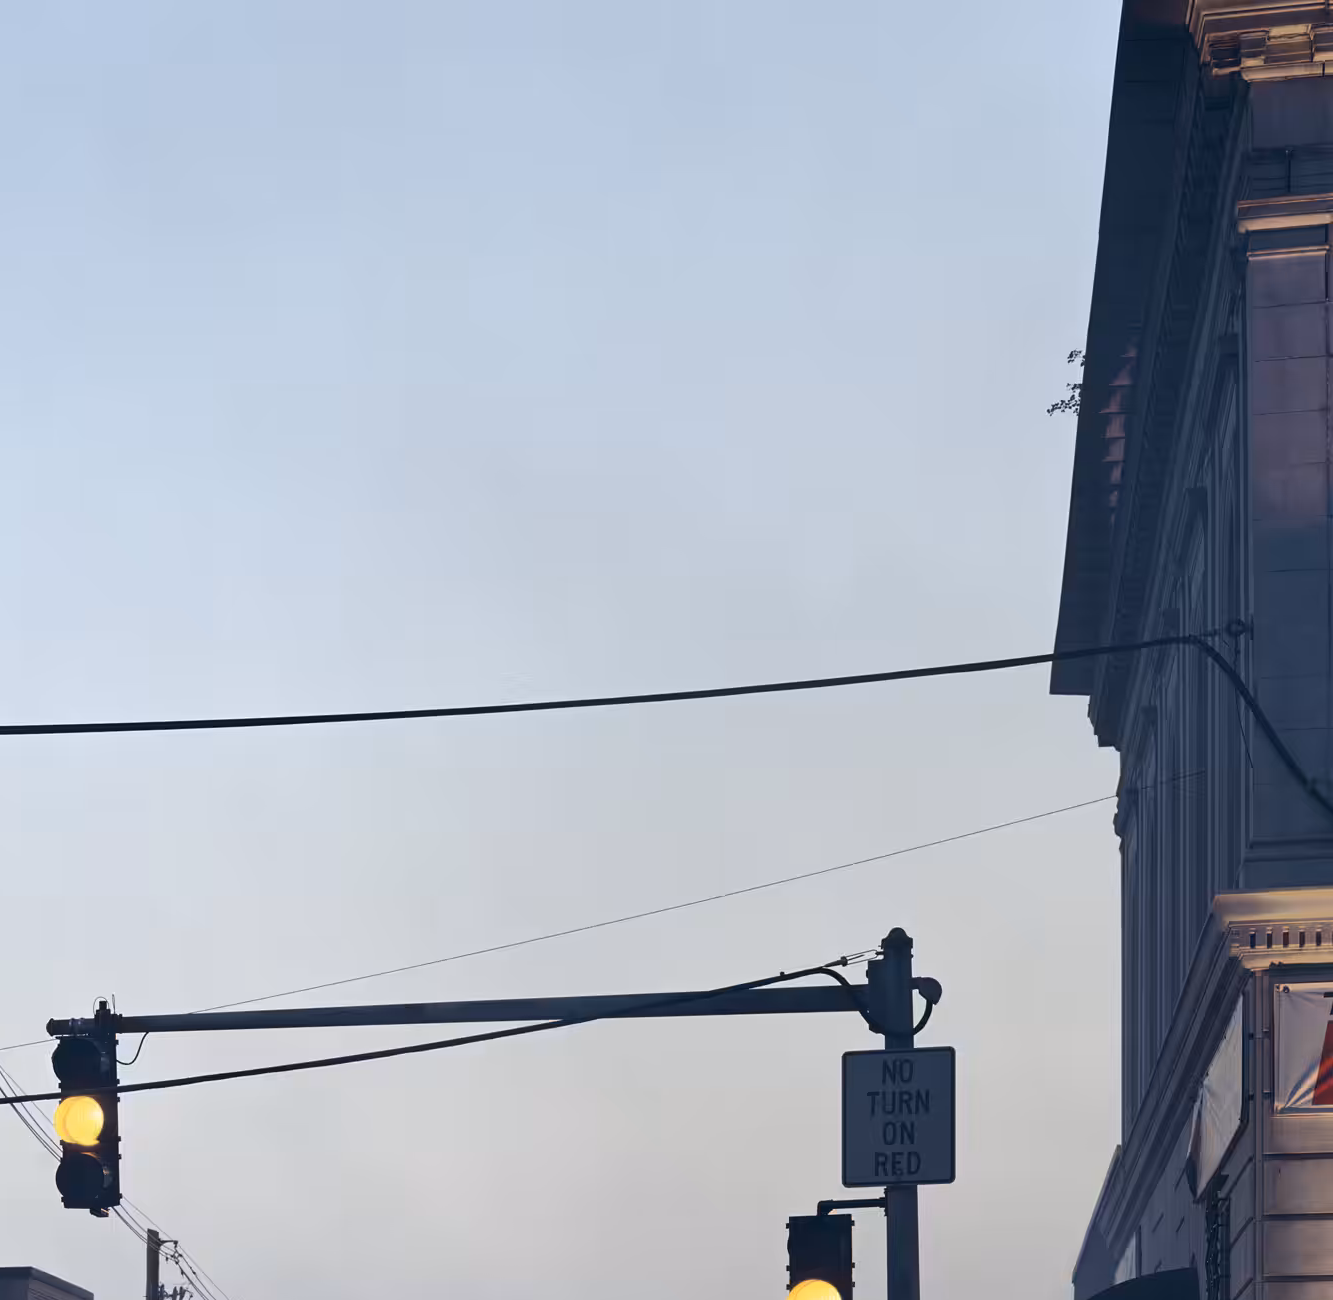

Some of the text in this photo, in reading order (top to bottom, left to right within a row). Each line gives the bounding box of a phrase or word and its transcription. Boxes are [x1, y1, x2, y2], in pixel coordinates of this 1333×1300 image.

[882, 1059, 914, 1085] NO
[867, 1089, 930, 1117] TURN
[883, 1121, 914, 1146] ON
[874, 1152, 921, 1177] RED
